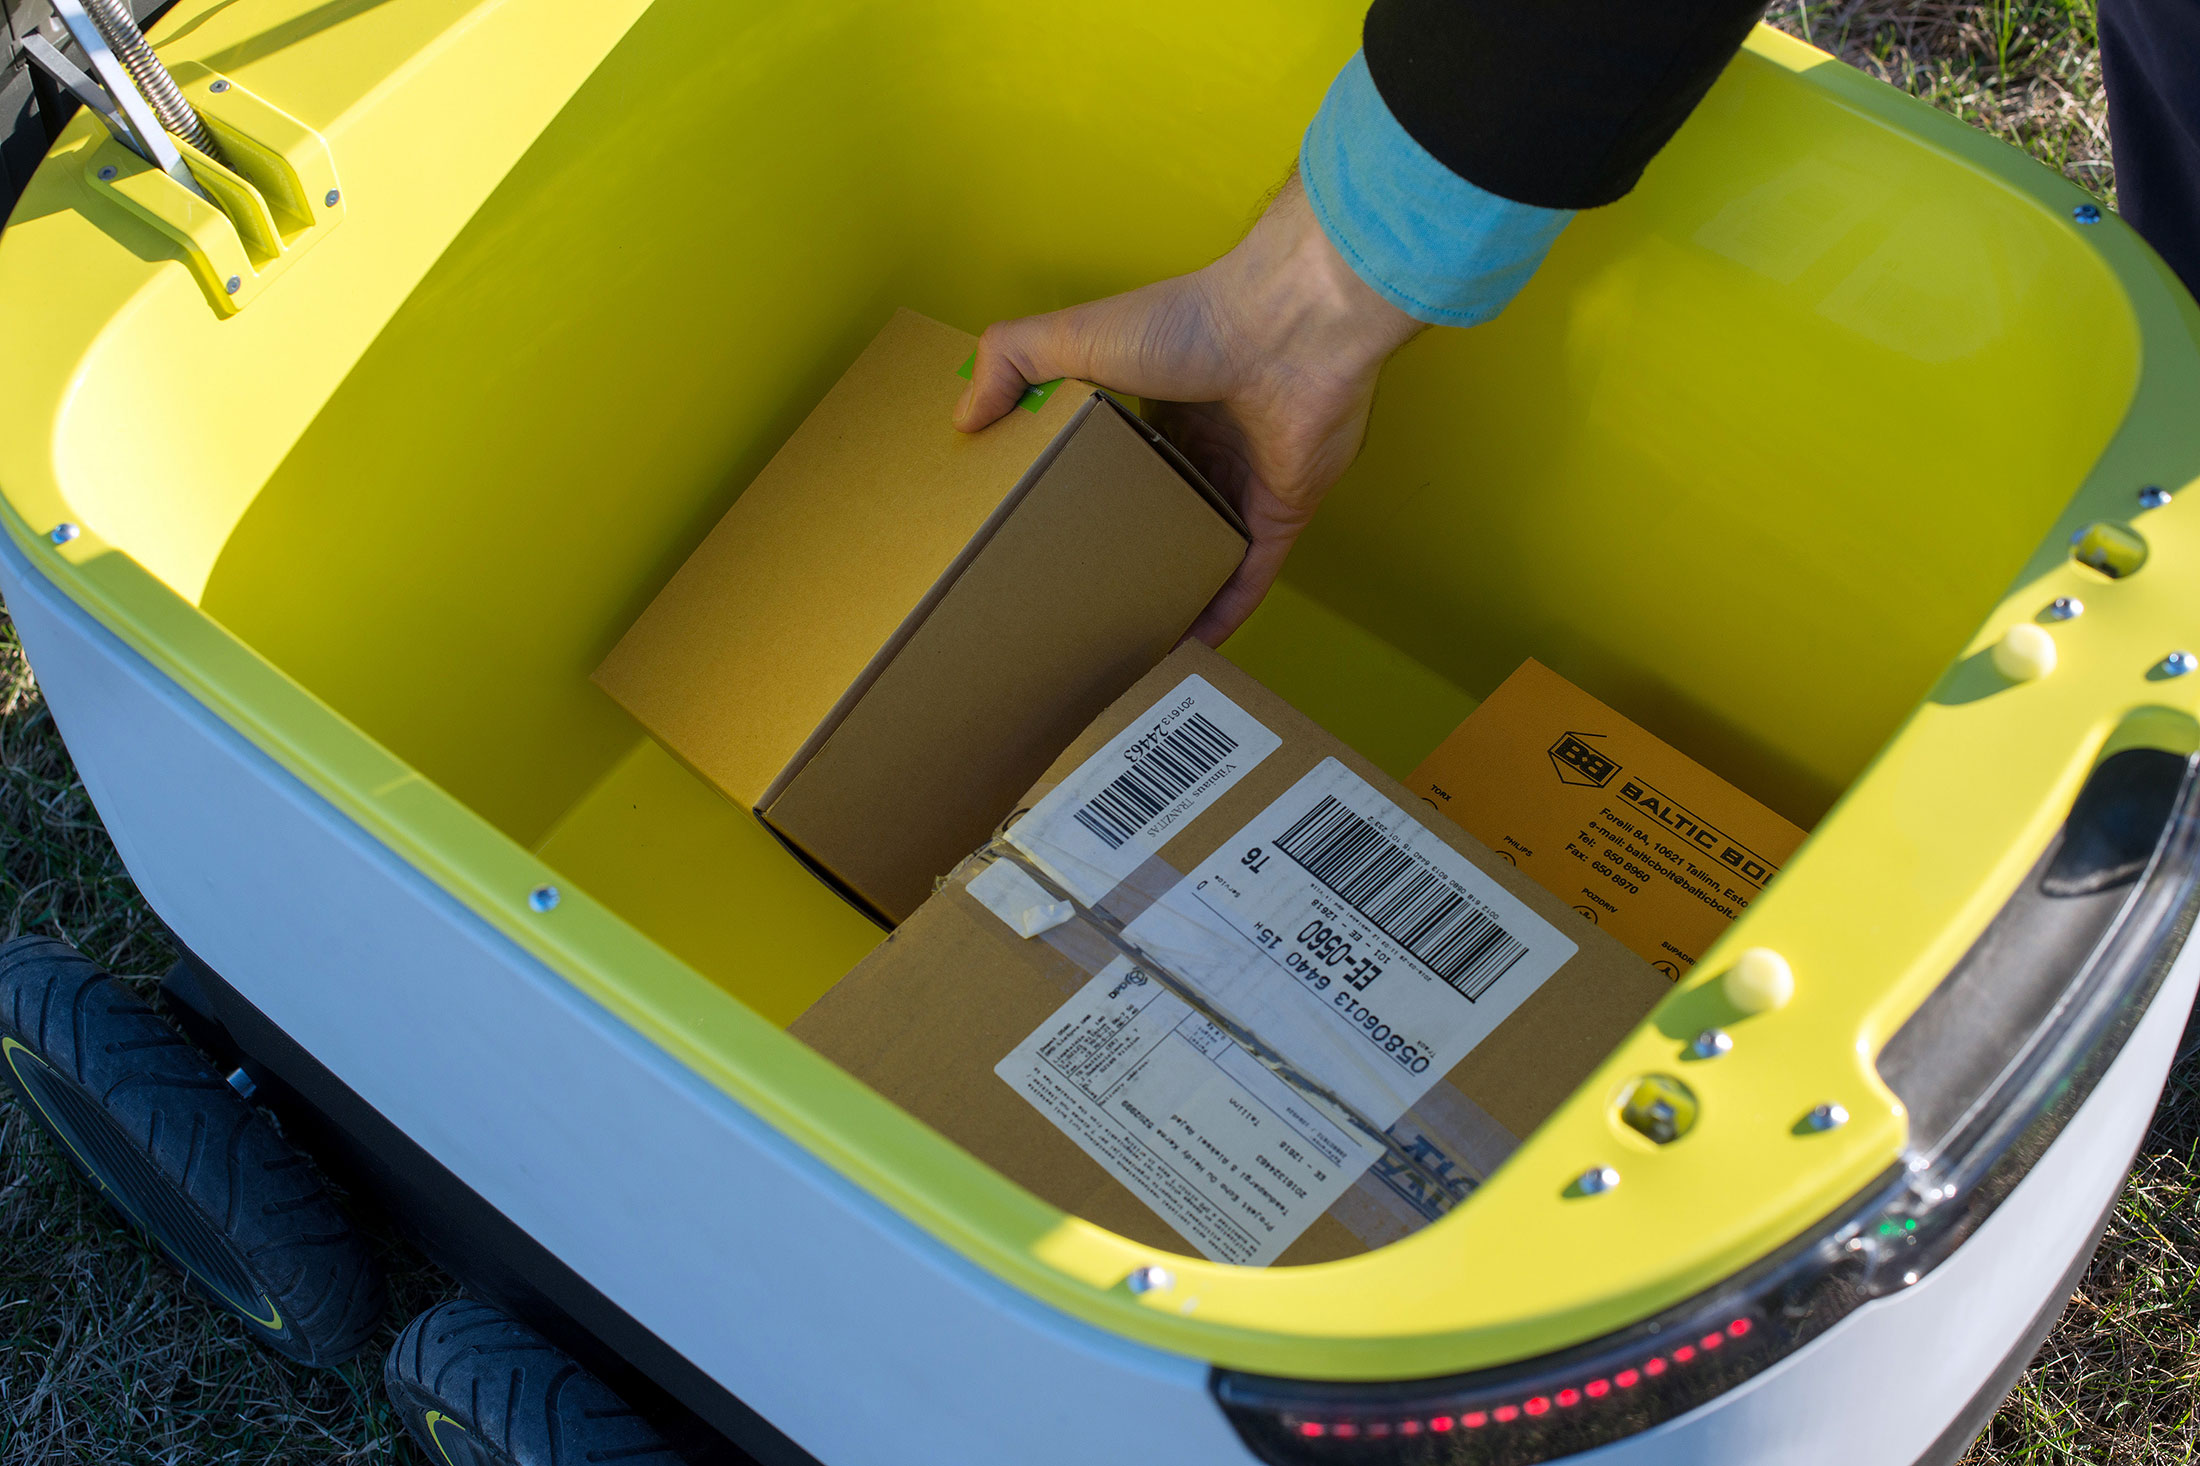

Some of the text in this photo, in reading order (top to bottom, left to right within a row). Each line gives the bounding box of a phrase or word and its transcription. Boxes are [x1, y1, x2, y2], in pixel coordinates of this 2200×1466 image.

[1146, 763, 1236, 838] Vilniaus TRANZITAS
[1430, 784, 1452, 801] TORX
[1619, 781, 1718, 849] BALTIC
[1503, 835, 1533, 857] PHILIPS
[1588, 820, 1626, 847] e-mail:
[1240, 847, 1271, 874] T6
[1577, 830, 1650, 882] Tel: 650 8960
[1599, 807, 1635, 833] Forelli
[1632, 829, 1651, 846] 8A,
[1653, 842, 1685, 866] 10621
[1685, 862, 1722, 892] Tallinn,
[1565, 842, 1639, 894] Fax: 650 8970
[1196, 880, 1208, 890] D
[1214, 875, 1241, 898] Service
[1310, 898, 1338, 921] 12618
[1581, 887, 1618, 913] POZIDRIV
[1348, 929, 1363, 942] EE
[1295, 919, 1383, 991] EE-0560
[1373, 949, 1391, 964] 101
[1284, 951, 1332, 990] 6440
[1108, 981, 1128, 999] DPD
[1416, 1040, 1436, 1058] Track
[1228, 1097, 1260, 1127] Tallinn
[1219, 1183, 1240, 1202] Echo
[1241, 1201, 1275, 1232] Projekt
